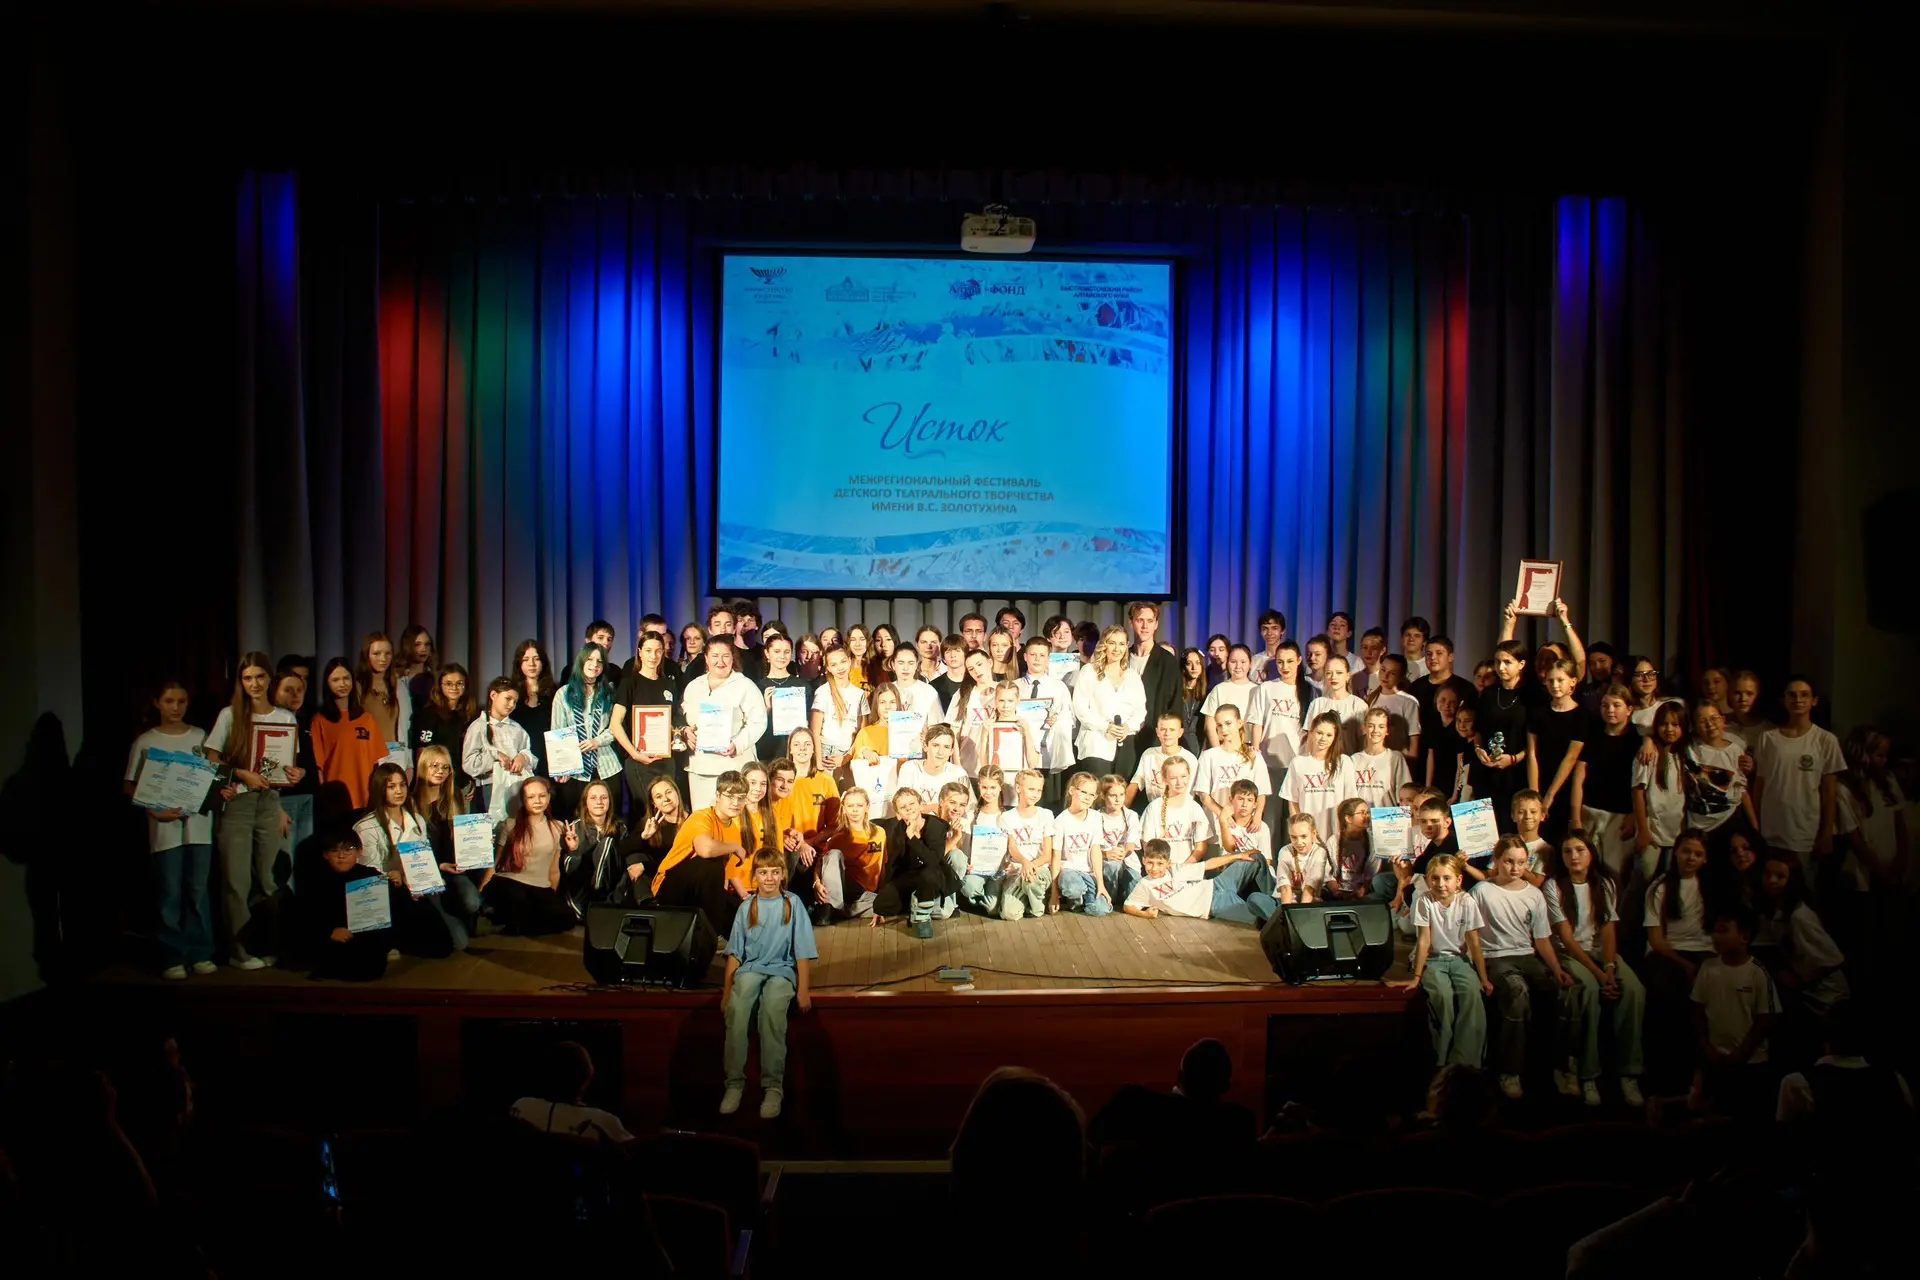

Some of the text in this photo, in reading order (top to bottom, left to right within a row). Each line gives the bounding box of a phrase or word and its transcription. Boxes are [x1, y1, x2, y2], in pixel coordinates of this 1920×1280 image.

[862, 402, 1009, 453] Исток
[848, 474, 1041, 488] МЕЖРЕГИОНАЛЬНЫЙ ФЕСТИВАЛЬ
[834, 488, 1055, 502] ДЕТСКОГО ТЕАТРАЛЬНОГО ТВОРЧЕСТВА
[872, 502, 1017, 514] ИМЕНИ В.С. ЗОЛОТУХИНА
[420, 730, 433, 742] 32
